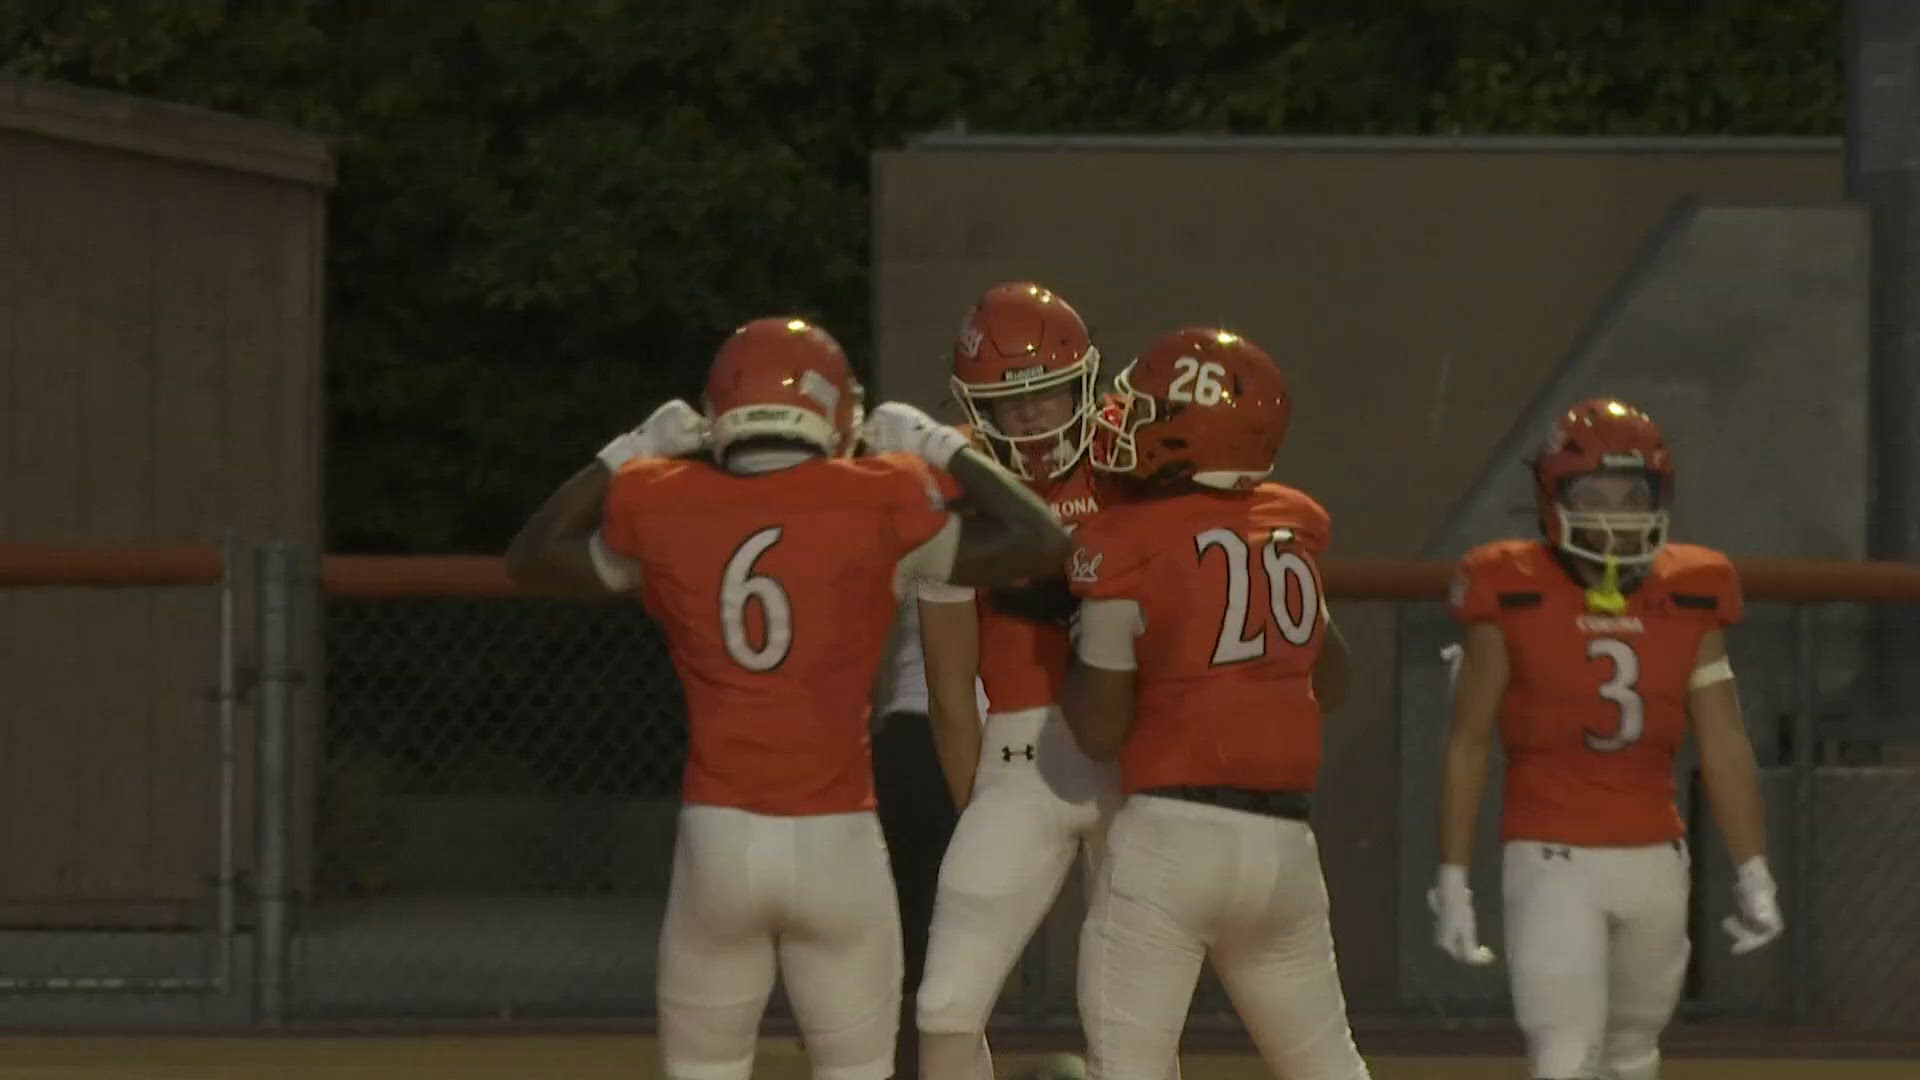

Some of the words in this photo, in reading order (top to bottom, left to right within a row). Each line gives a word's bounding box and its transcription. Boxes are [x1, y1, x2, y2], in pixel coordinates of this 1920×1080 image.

[1168, 357, 1226, 407] 26
[1049, 496, 1099, 518] RONA
[718, 524, 794, 673] 6
[1193, 523, 1319, 669] 26
[1584, 638, 1644, 752] 3
